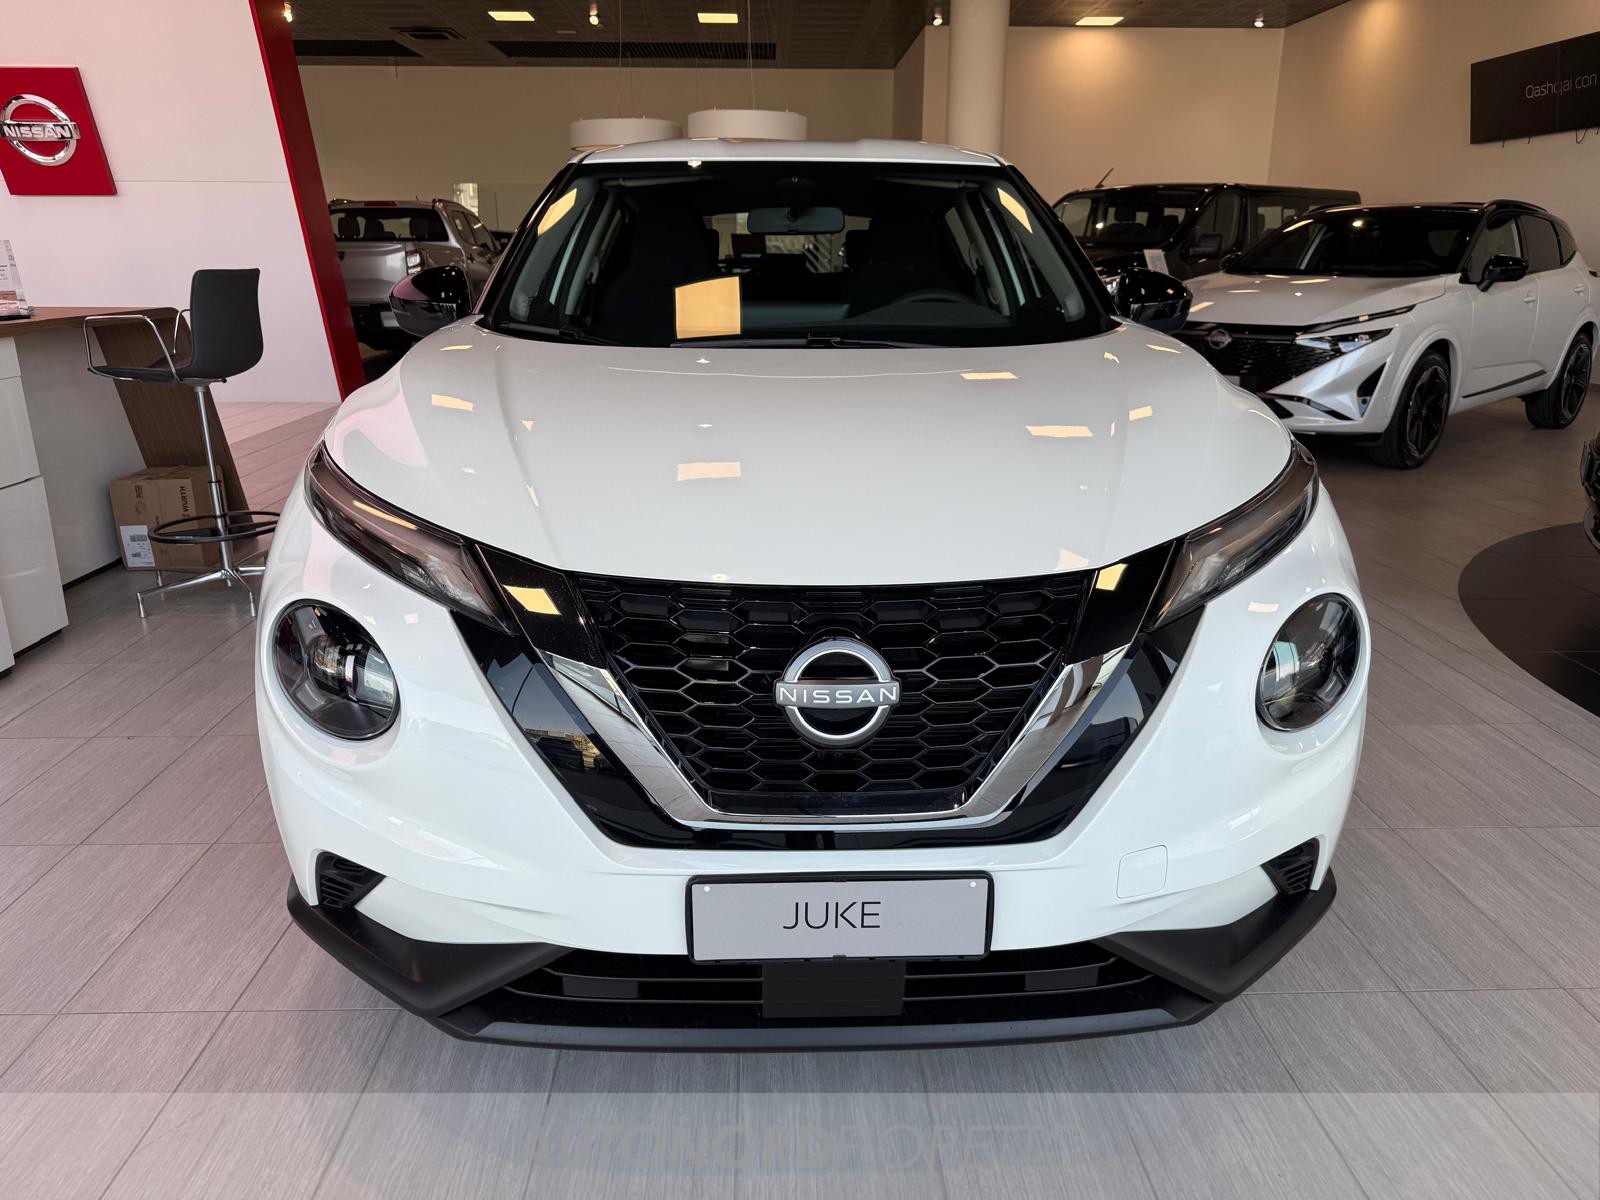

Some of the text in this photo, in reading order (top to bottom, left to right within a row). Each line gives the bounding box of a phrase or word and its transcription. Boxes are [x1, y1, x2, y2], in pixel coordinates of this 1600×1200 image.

[2, 124, 72, 138] NISSAN
[779, 686, 897, 704] NISSAN
[782, 901, 882, 930] JUKE
